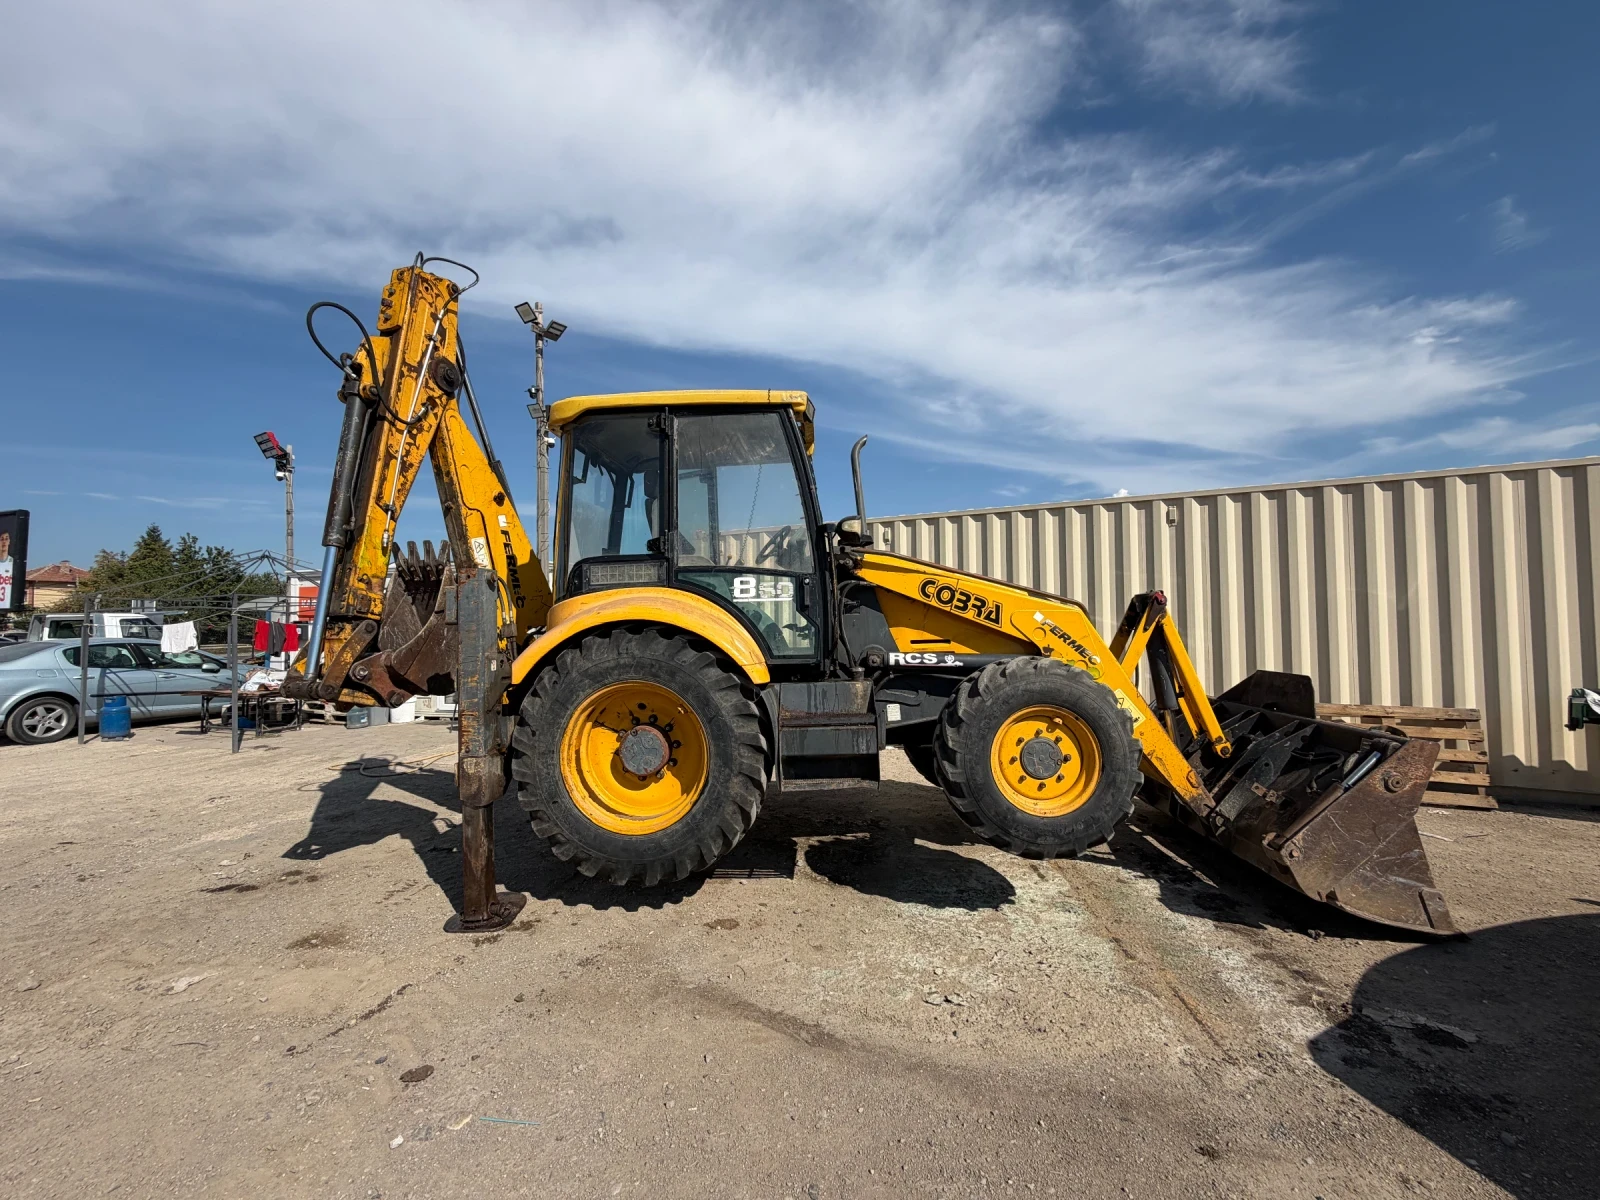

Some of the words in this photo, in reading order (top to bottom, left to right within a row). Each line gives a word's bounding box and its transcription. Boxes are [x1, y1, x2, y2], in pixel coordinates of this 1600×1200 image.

[500, 529, 527, 609] FERMEC
[918, 578, 1003, 628] COBRA
[889, 652, 938, 666] RCS
[1041, 619, 1100, 666] FERMEC
